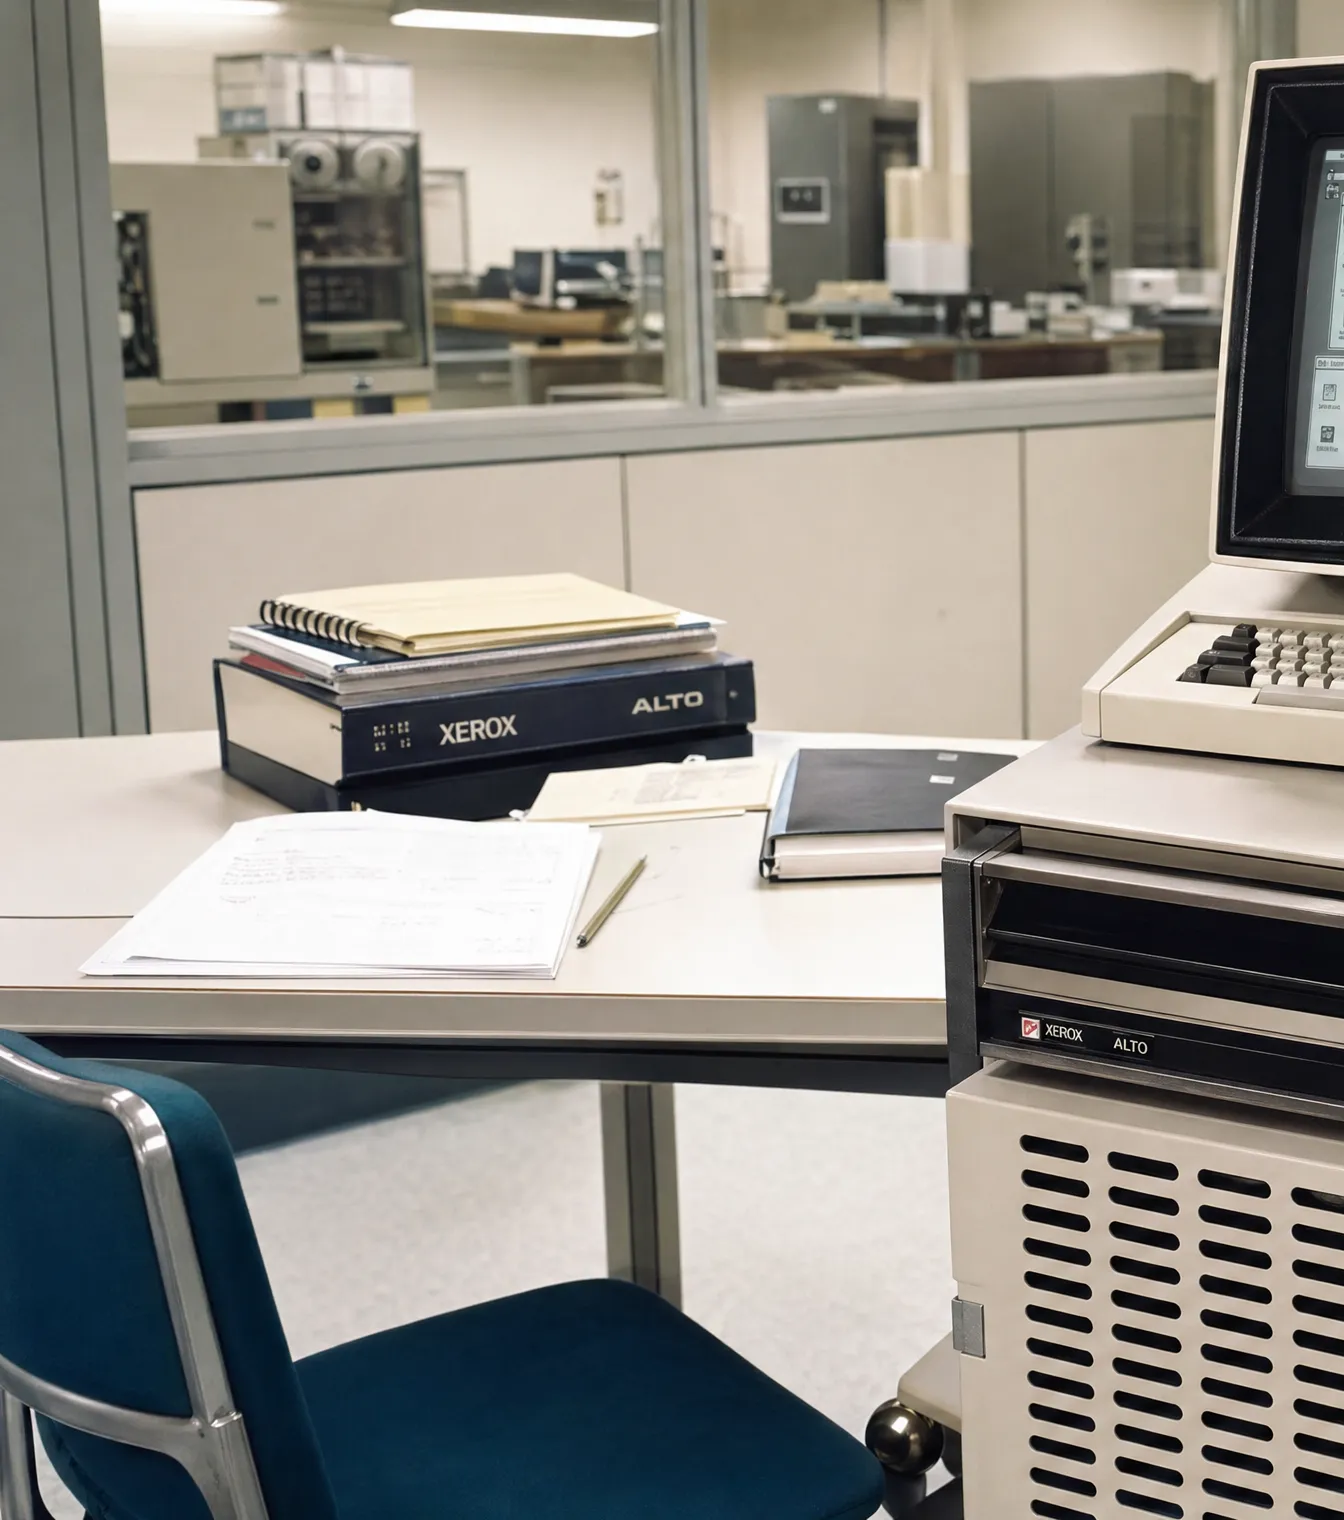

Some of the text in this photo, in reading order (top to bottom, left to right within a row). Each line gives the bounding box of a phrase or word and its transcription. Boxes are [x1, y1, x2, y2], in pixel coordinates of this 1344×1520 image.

[439, 714, 518, 746] XEROX
[631, 691, 704, 716] ALTO
[1045, 1023, 1148, 1055] XEROX ALTO
